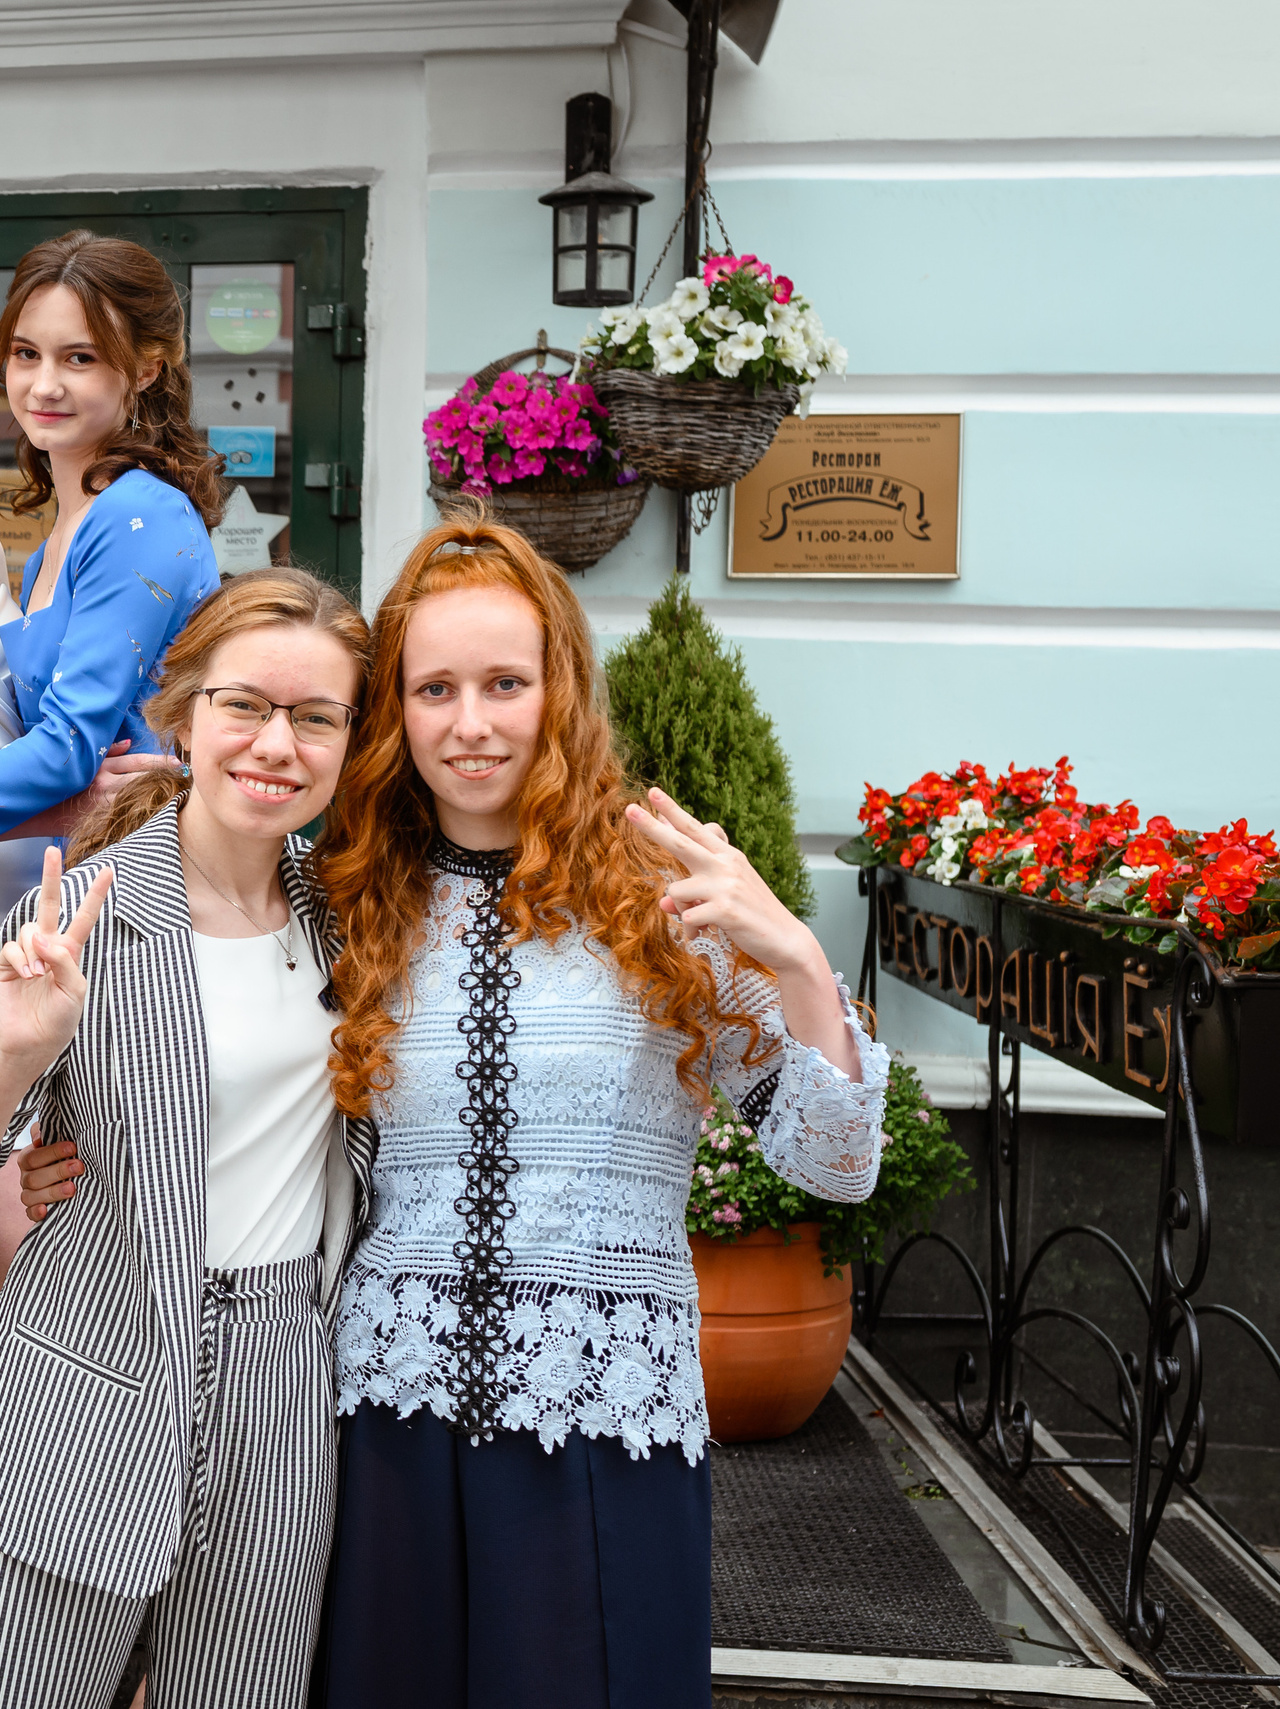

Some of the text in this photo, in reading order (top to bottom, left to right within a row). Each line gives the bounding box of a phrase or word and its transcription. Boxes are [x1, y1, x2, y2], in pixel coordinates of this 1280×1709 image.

[812, 450, 881, 469] Ресторан
[788, 476, 903, 502] РЕСТОРАЦИЯ ЁЖ
[797, 530, 894, 542] 11.00-24.00
